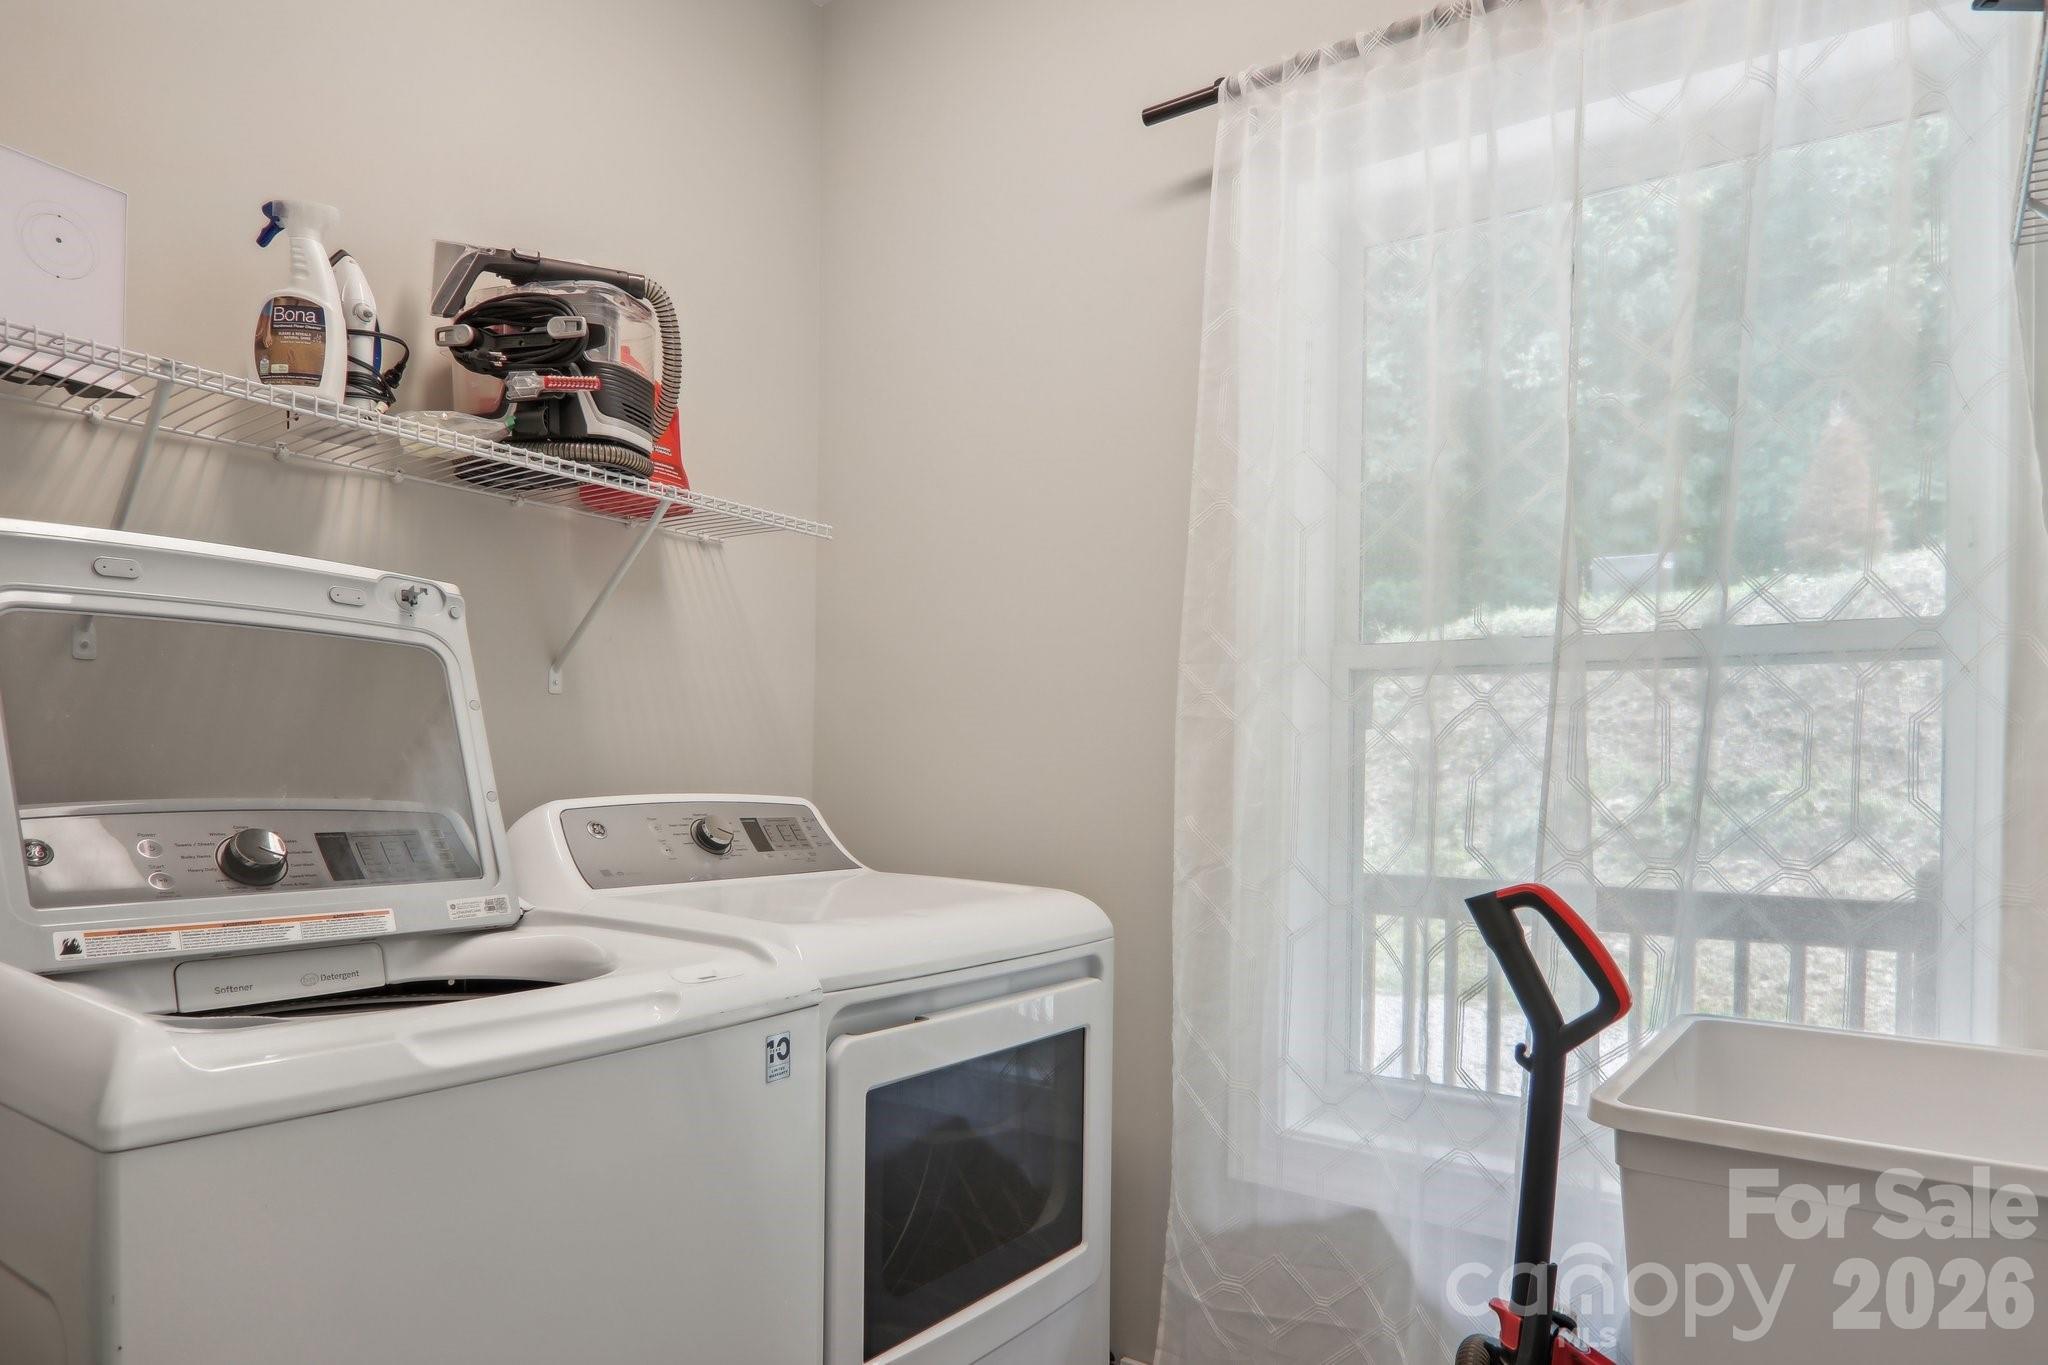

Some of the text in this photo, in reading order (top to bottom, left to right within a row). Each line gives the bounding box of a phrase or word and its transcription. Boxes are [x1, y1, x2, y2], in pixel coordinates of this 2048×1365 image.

[273, 306, 316, 323] Bona
[320, 970, 359, 982] Detergent
[214, 984, 253, 994] Softener
[767, 1037, 790, 1063] 10
